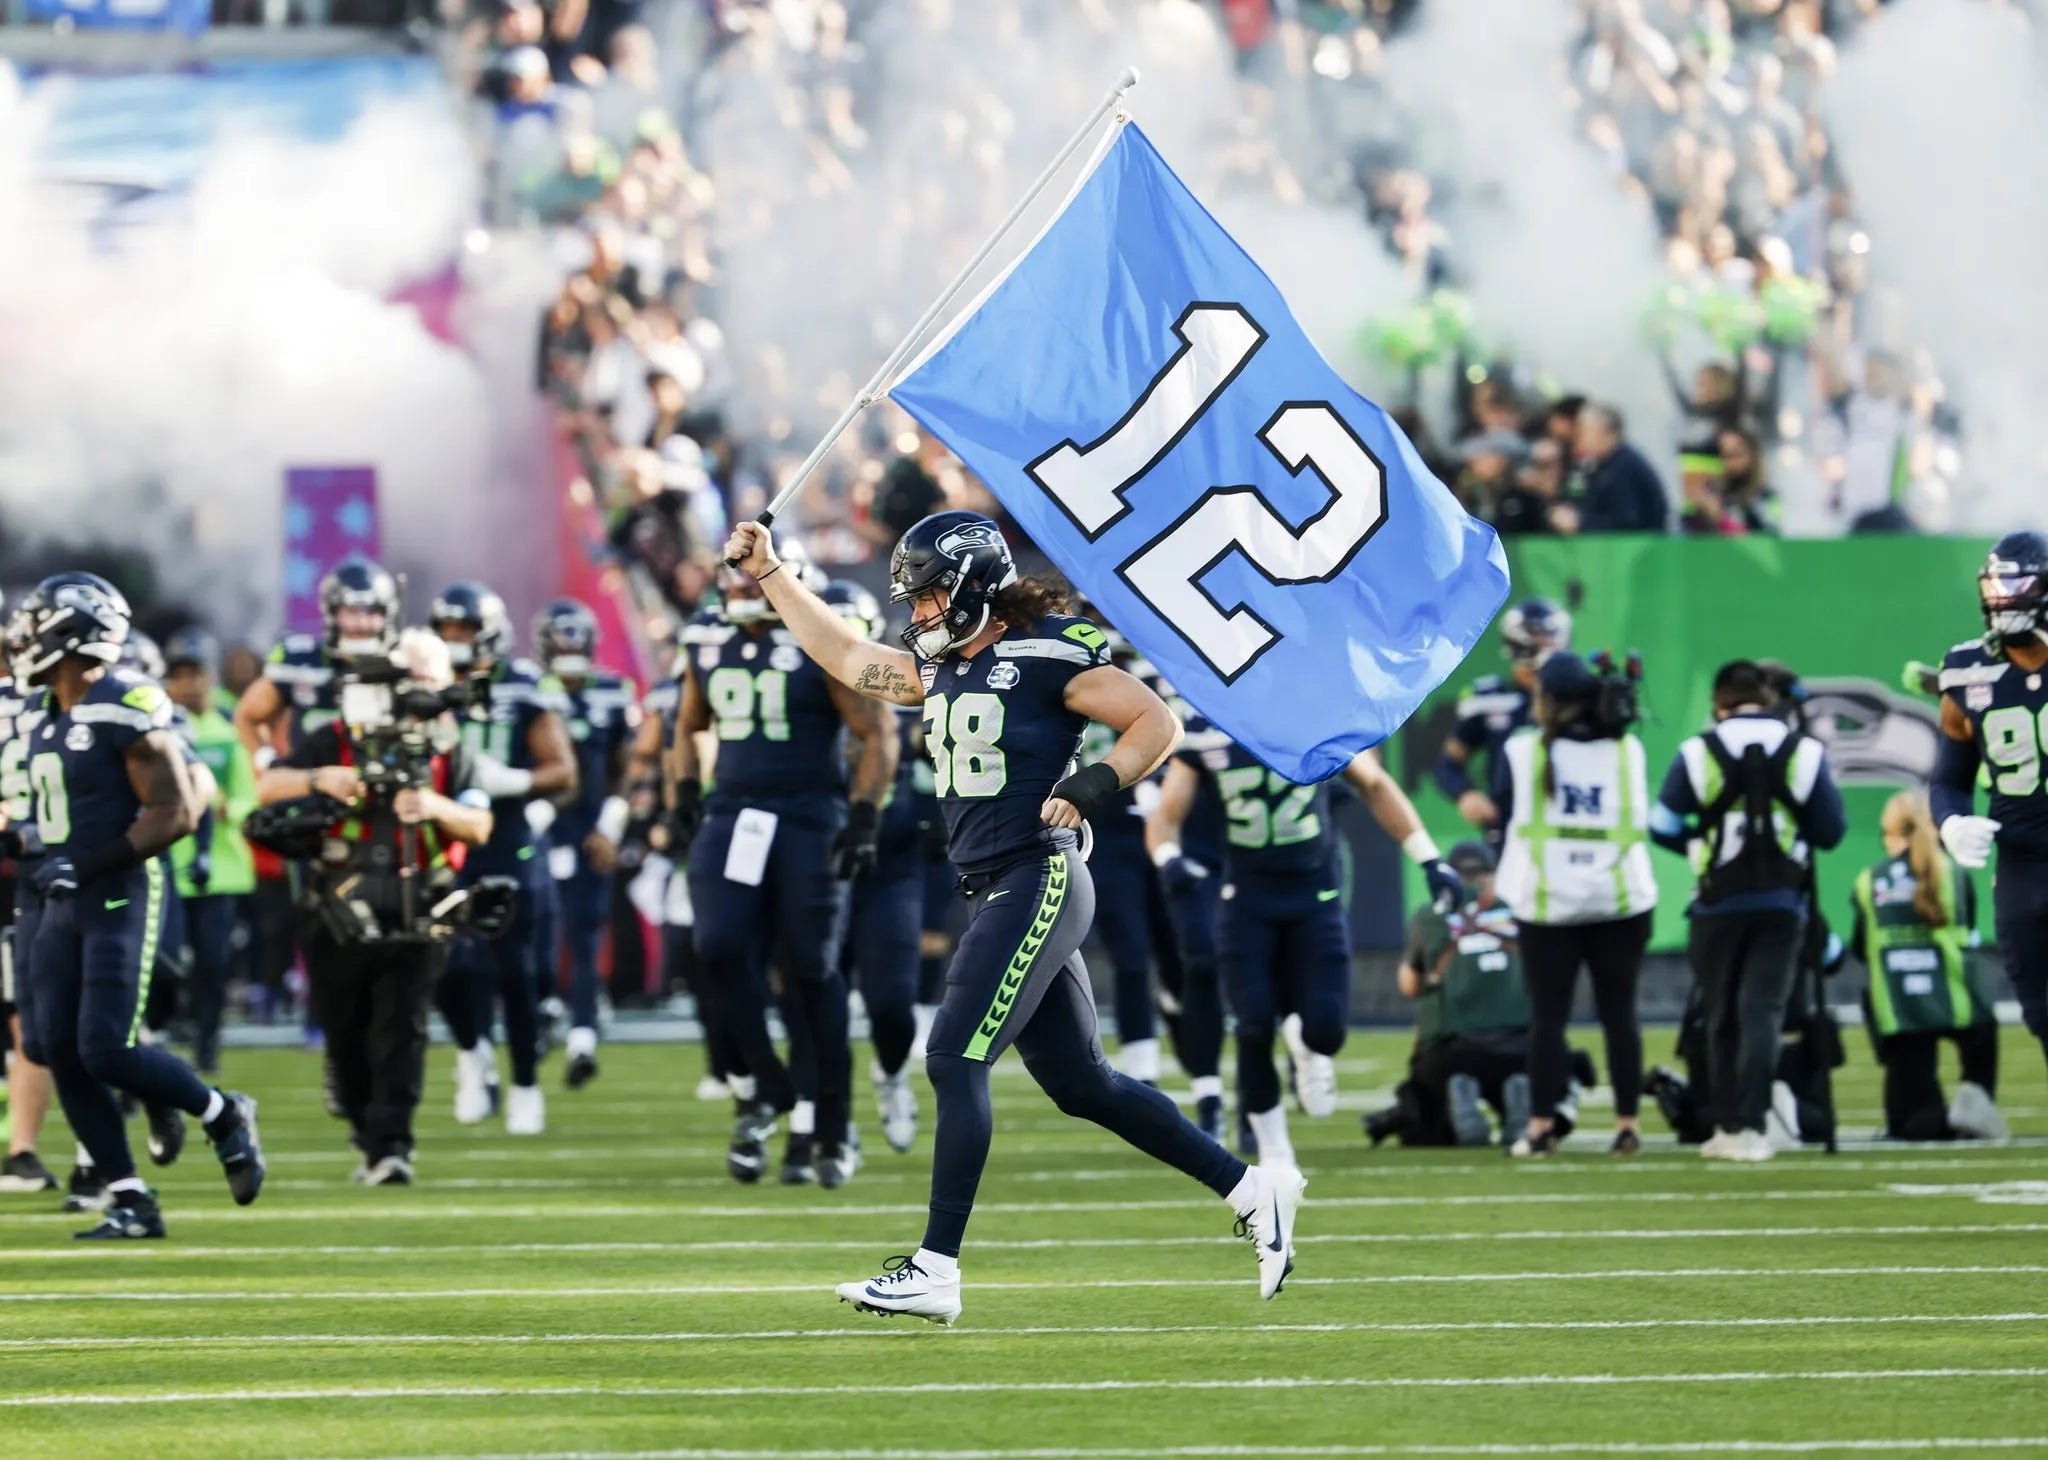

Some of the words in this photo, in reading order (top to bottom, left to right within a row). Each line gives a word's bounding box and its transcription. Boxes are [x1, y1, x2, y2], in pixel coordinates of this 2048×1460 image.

[1023, 301, 1389, 687] 12
[708, 667, 791, 741] 91
[1982, 704, 2048, 796] 9
[1217, 765, 1320, 848] 52
